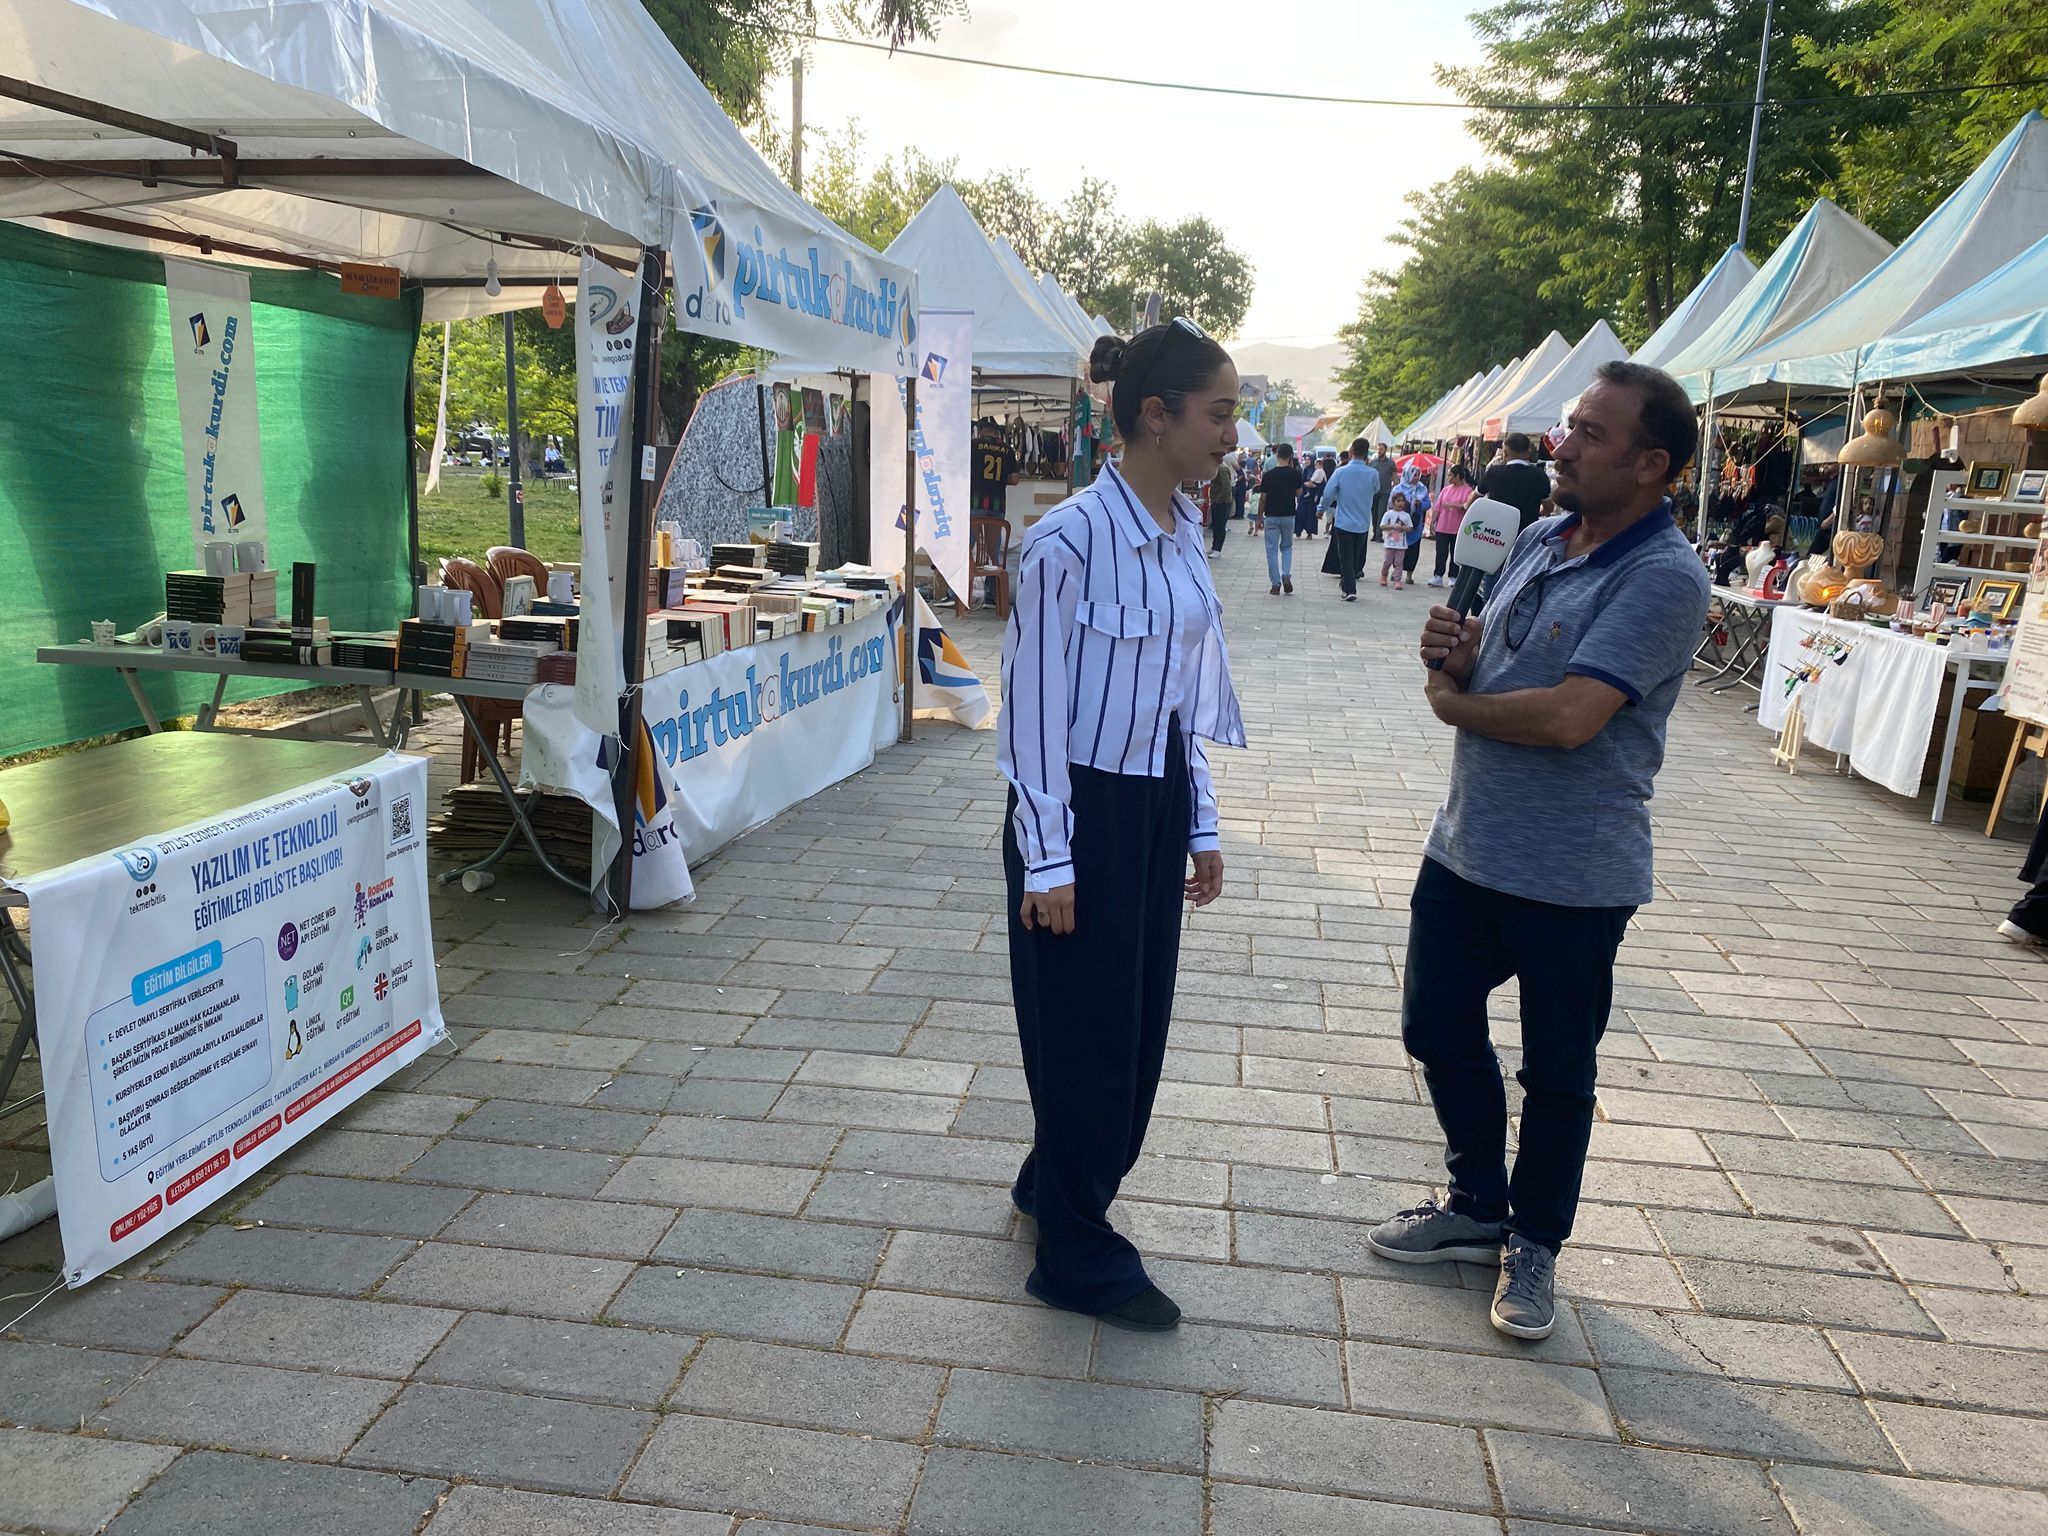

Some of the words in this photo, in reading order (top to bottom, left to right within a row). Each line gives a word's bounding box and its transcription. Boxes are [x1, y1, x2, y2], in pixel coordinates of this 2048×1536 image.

[685, 286, 731, 325] dara
[202, 315, 239, 535] pirtukakurdi.com
[983, 454, 1002, 481] 21
[1472, 532, 1506, 547] GÜNDEM
[1483, 527, 1502, 537] MED
[220, 821, 236, 832] VE
[191, 844, 251, 895] YAZILIM
[253, 836, 272, 869] VE
[273, 804, 338, 861] TEKNOLOJİ
[194, 882, 252, 931] EĞİTİMLERİ
[300, 846, 344, 882] BAŞLIYOR!
[368, 890, 394, 909] KODLAMA
[129, 894, 167, 915] tekmerbitlis
[310, 911, 325, 926] CORE
[325, 906, 337, 920] WEB
[300, 934, 310, 945] API
[310, 922, 330, 940] EĞİTİMİ
[375, 925, 389, 939] SİBER
[375, 932, 399, 951] GÜVENLİK
[144, 968, 174, 997] EĞİTİM
[175, 949, 213, 984] BİLGİLERİ
[302, 962, 324, 981] GOLANG
[390, 959, 414, 978] İNGİLİZCE
[303, 974, 323, 994] EĞİTİMİ
[391, 974, 408, 990] EĞİTİM
[115, 1020, 137, 1039] DEVLET
[137, 1010, 158, 1027] ONAYLI
[159, 996, 187, 1016] SERTİFİKA
[187, 978, 225, 1002] VERİLECEKTİR
[342, 990, 352, 1006] Qt
[305, 1012, 321, 1029] LİNUX
[336, 1018, 343, 1030] QT
[342, 1005, 361, 1026] EĞİTİMİ
[111, 1047, 132, 1067] BAŞARI
[132, 1030, 167, 1055] SERTİFİKASI
[167, 1018, 190, 1037] ALMAYA
[189, 1011, 202, 1025] HAK
[202, 993, 240, 1018] KAZANANLARA
[306, 1021, 325, 1041] EĞİTİMİ
[112, 1051, 151, 1080] ŞİRKETİMİZİN
[151, 1040, 169, 1057] PROJE
[169, 1026, 197, 1047] BİRİMİNDE
[197, 1021, 204, 1032] İŞ
[203, 1013, 223, 1030] İMKANI
[115, 1074, 153, 1103] KURSİYERLER
[153, 1063, 170, 1080] KENDİ
[169, 1037, 221, 1071] BİLGİSAYARLARIYLA
[221, 1013, 264, 1043] KATILMALIDIRLAR
[118, 1104, 145, 1126] BAŞVURU
[145, 1089, 170, 1110] SONRASI
[170, 1064, 213, 1096] DEĞERLENDİRME
[212, 1059, 220, 1070] VE
[220, 1047, 242, 1066] SEÇİLME
[241, 1038, 258, 1054] SINAVI
[119, 1112, 152, 1138] OLACAKTIR
[154, 1160, 175, 1180] EĞİTİM
[175, 1142, 207, 1166] YERLERİMİZ
[207, 1129, 224, 1146] BİTLİS
[224, 1111, 252, 1135] TEKNOLOJİ
[273, 1085, 292, 1102] TATVAN
[122, 1152, 127, 1161] 5
[127, 1145, 139, 1158] YAŞ
[139, 1133, 154, 1151] ÜSTÜ
